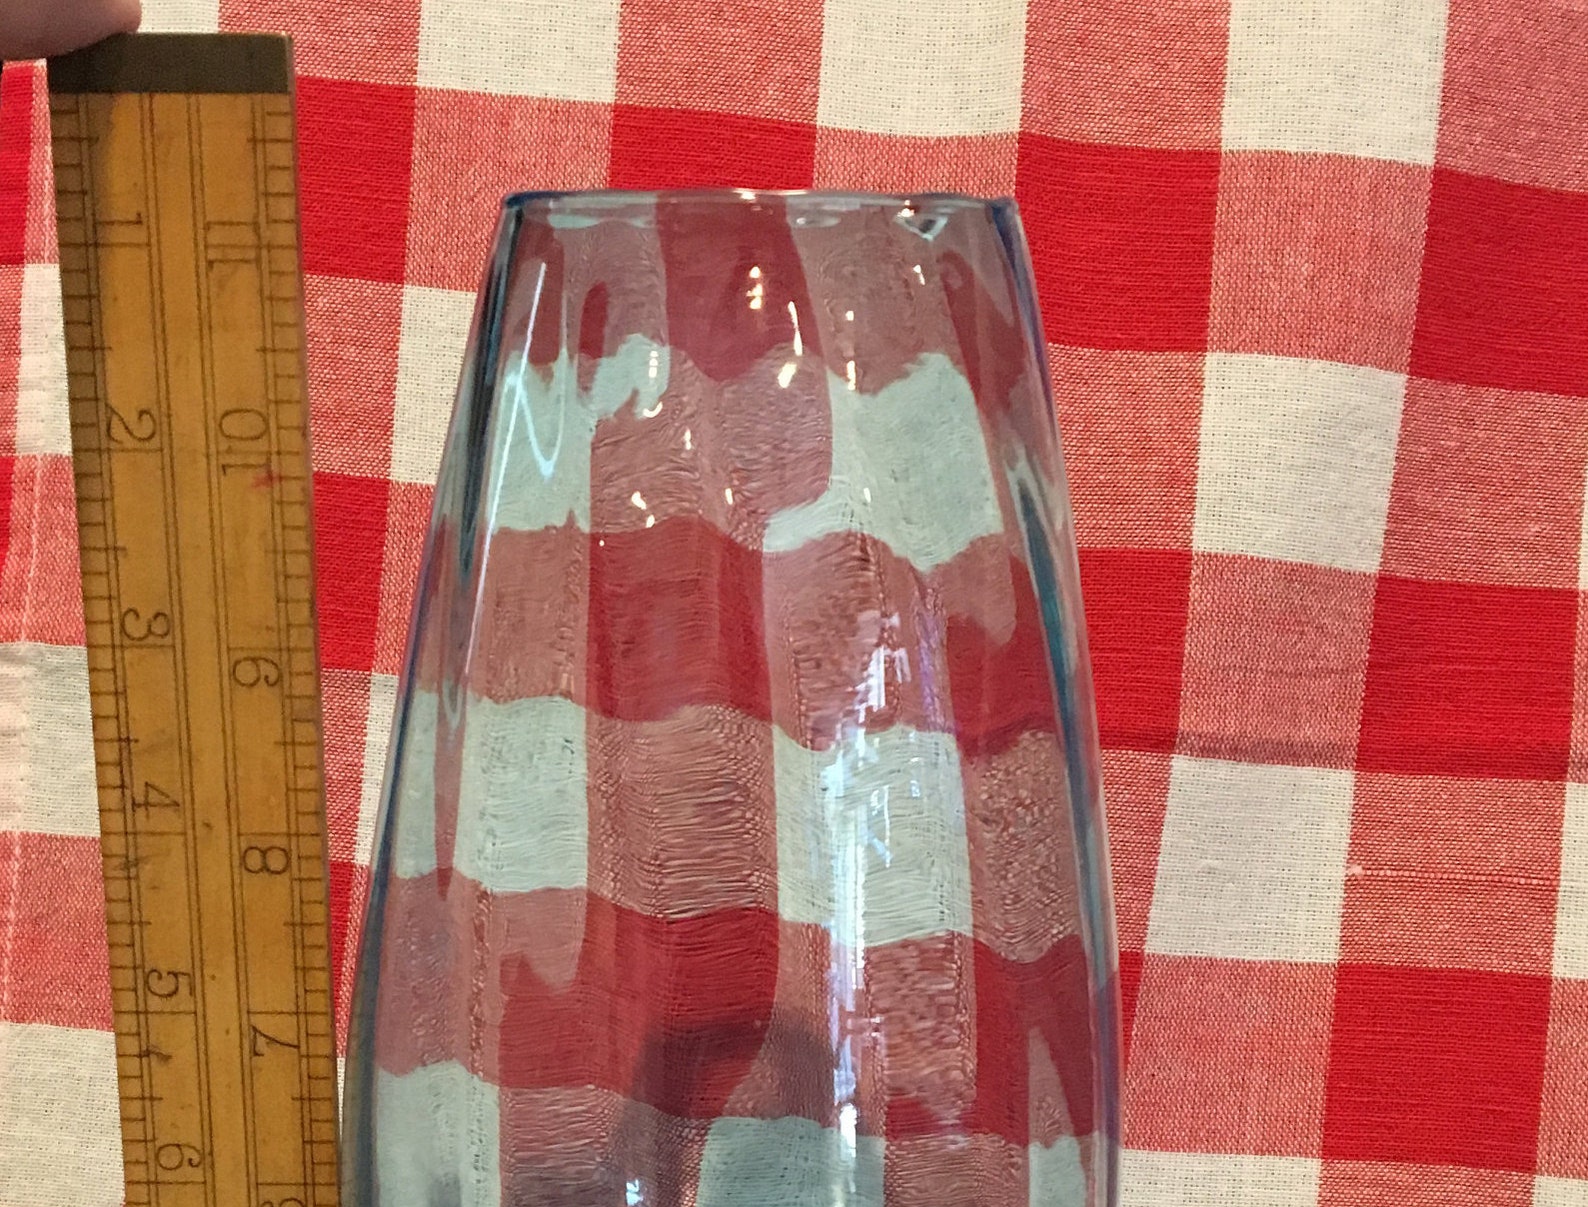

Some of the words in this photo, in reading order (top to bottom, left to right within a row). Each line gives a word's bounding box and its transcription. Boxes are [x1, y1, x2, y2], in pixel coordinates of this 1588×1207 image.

[206, 219, 261, 269] 11
[105, 403, 159, 444] 2
[218, 406, 270, 477] 10
[120, 607, 172, 643] 3
[232, 655, 282, 689] 9
[131, 781, 182, 820] 4
[242, 845, 290, 876] 8
[146, 967, 195, 1000] 5
[251, 1025, 301, 1058] 7
[156, 1142, 203, 1172] 6
